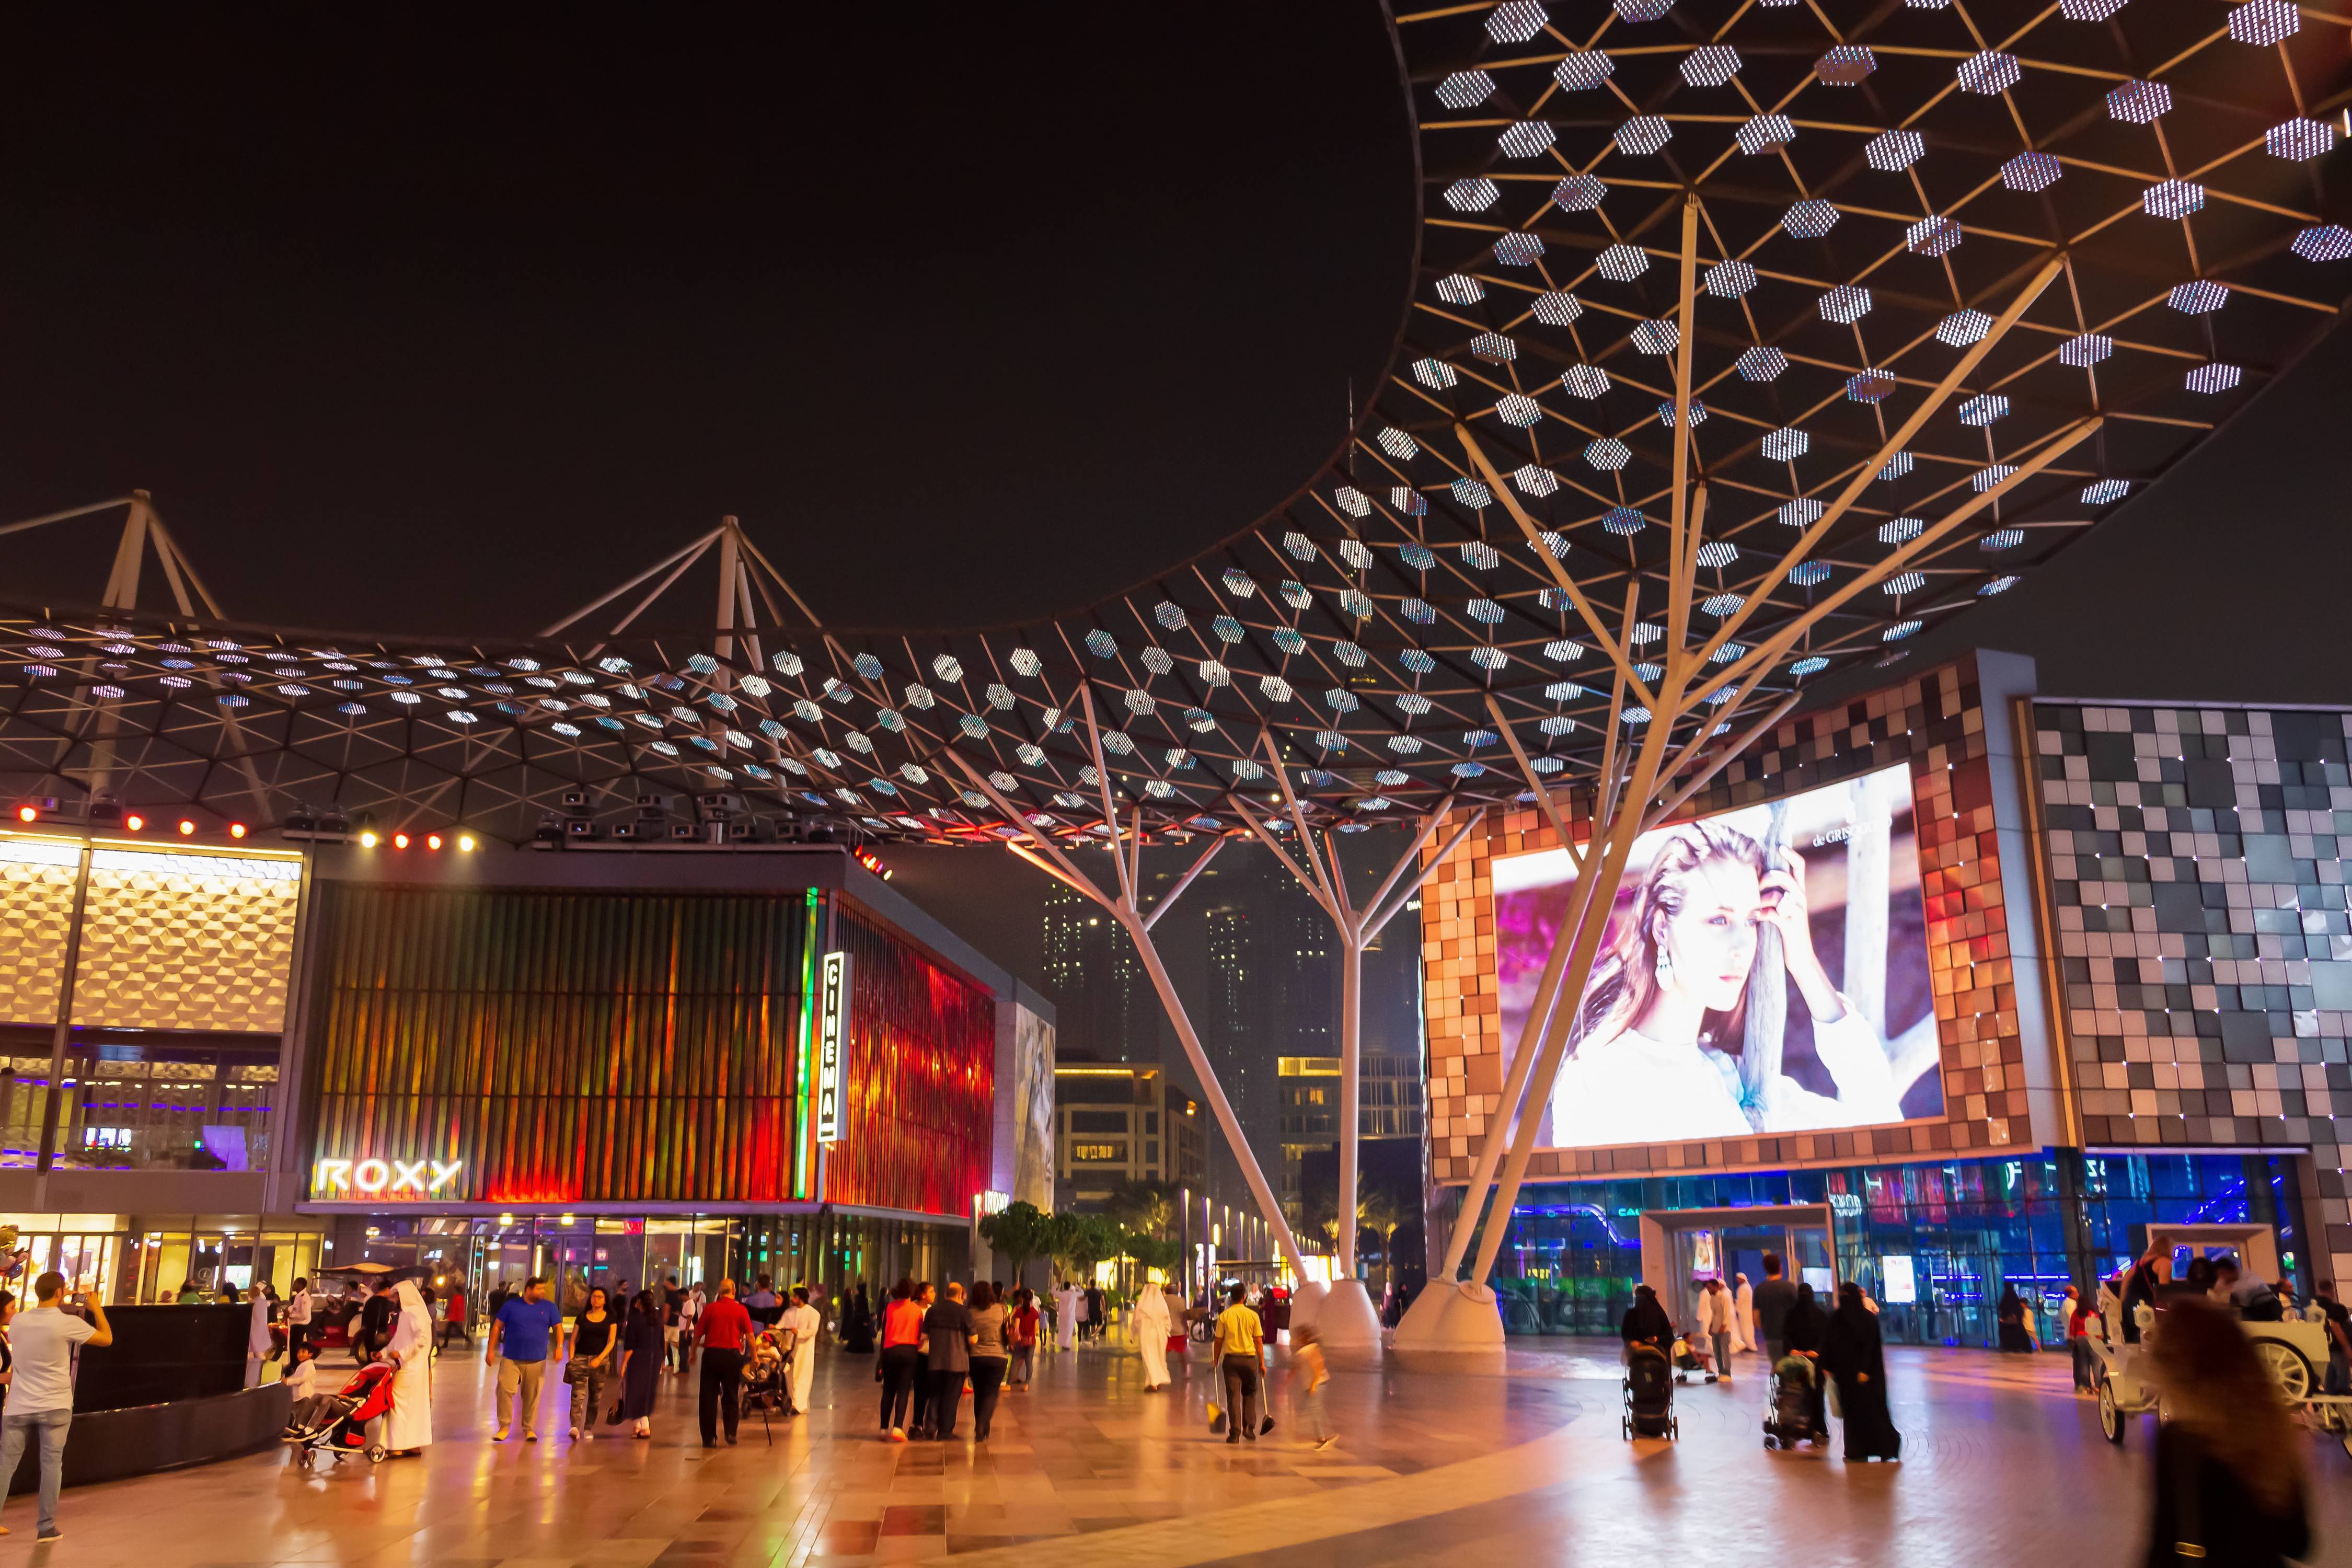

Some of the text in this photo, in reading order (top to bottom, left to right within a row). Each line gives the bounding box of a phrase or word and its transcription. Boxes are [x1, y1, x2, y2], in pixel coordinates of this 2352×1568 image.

[1813, 834, 1825, 847] de
[822, 964, 838, 1116] CINEMA
[317, 1159, 463, 1191] ROXY
